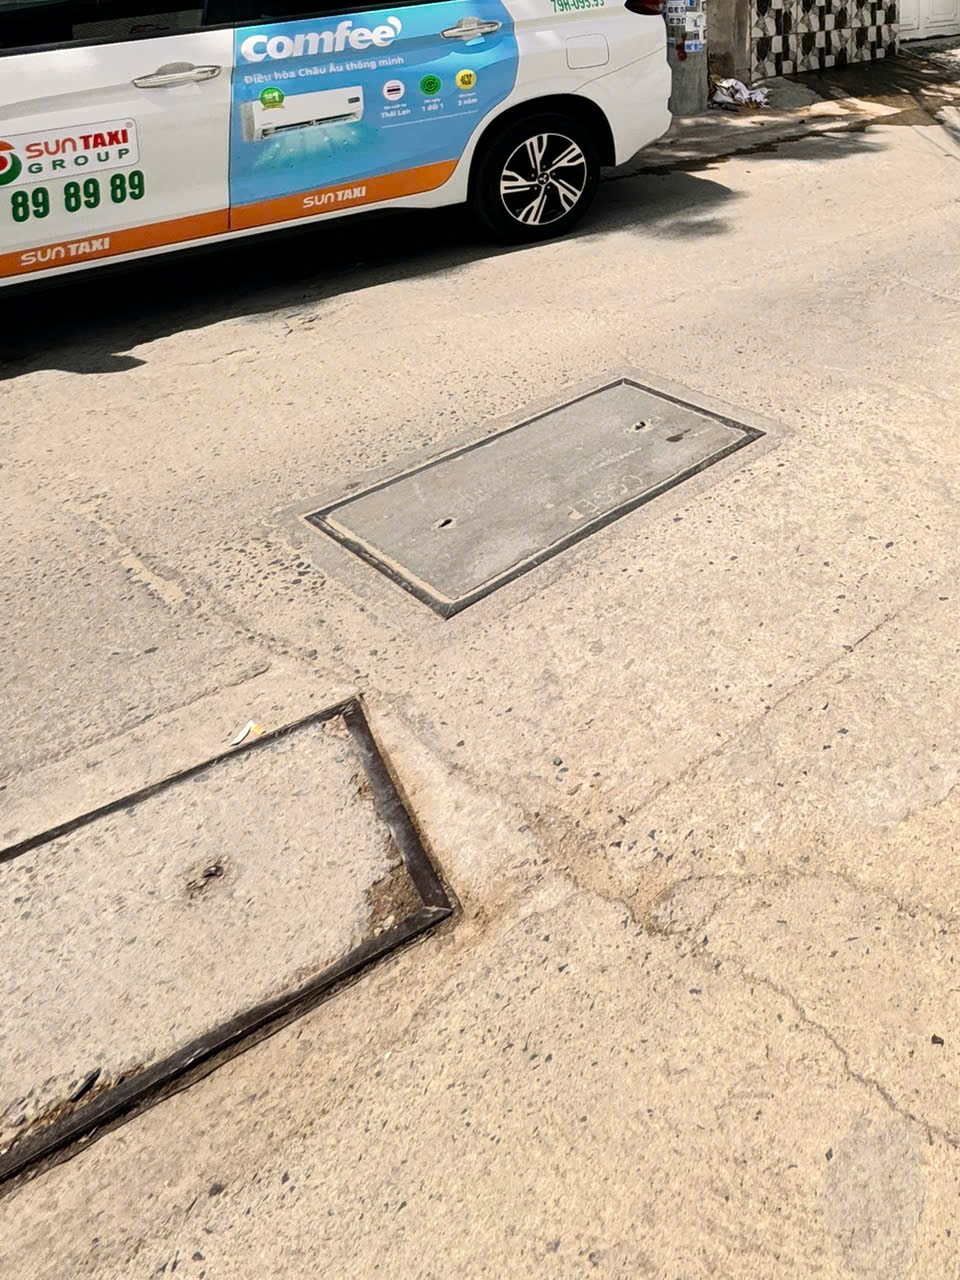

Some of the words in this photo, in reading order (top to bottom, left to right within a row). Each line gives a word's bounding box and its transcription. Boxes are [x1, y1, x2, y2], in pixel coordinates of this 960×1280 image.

[244, 73, 271, 85] Điều
[274, 70, 296, 80] hòa
[298, 66, 327, 77] Châu
[329, 62, 344, 73] Âu
[345, 60, 377, 70] thông
[379, 56, 405, 66] minh
[79, 129, 129, 151] TAXI
[28, 148, 130, 174] GROUP
[11, 190, 51, 223] 89
[64, 178, 101, 212] 89
[110, 170, 145, 204] 89
[336, 185, 367, 202] TAXI
[67, 237, 110, 256] TAXI
